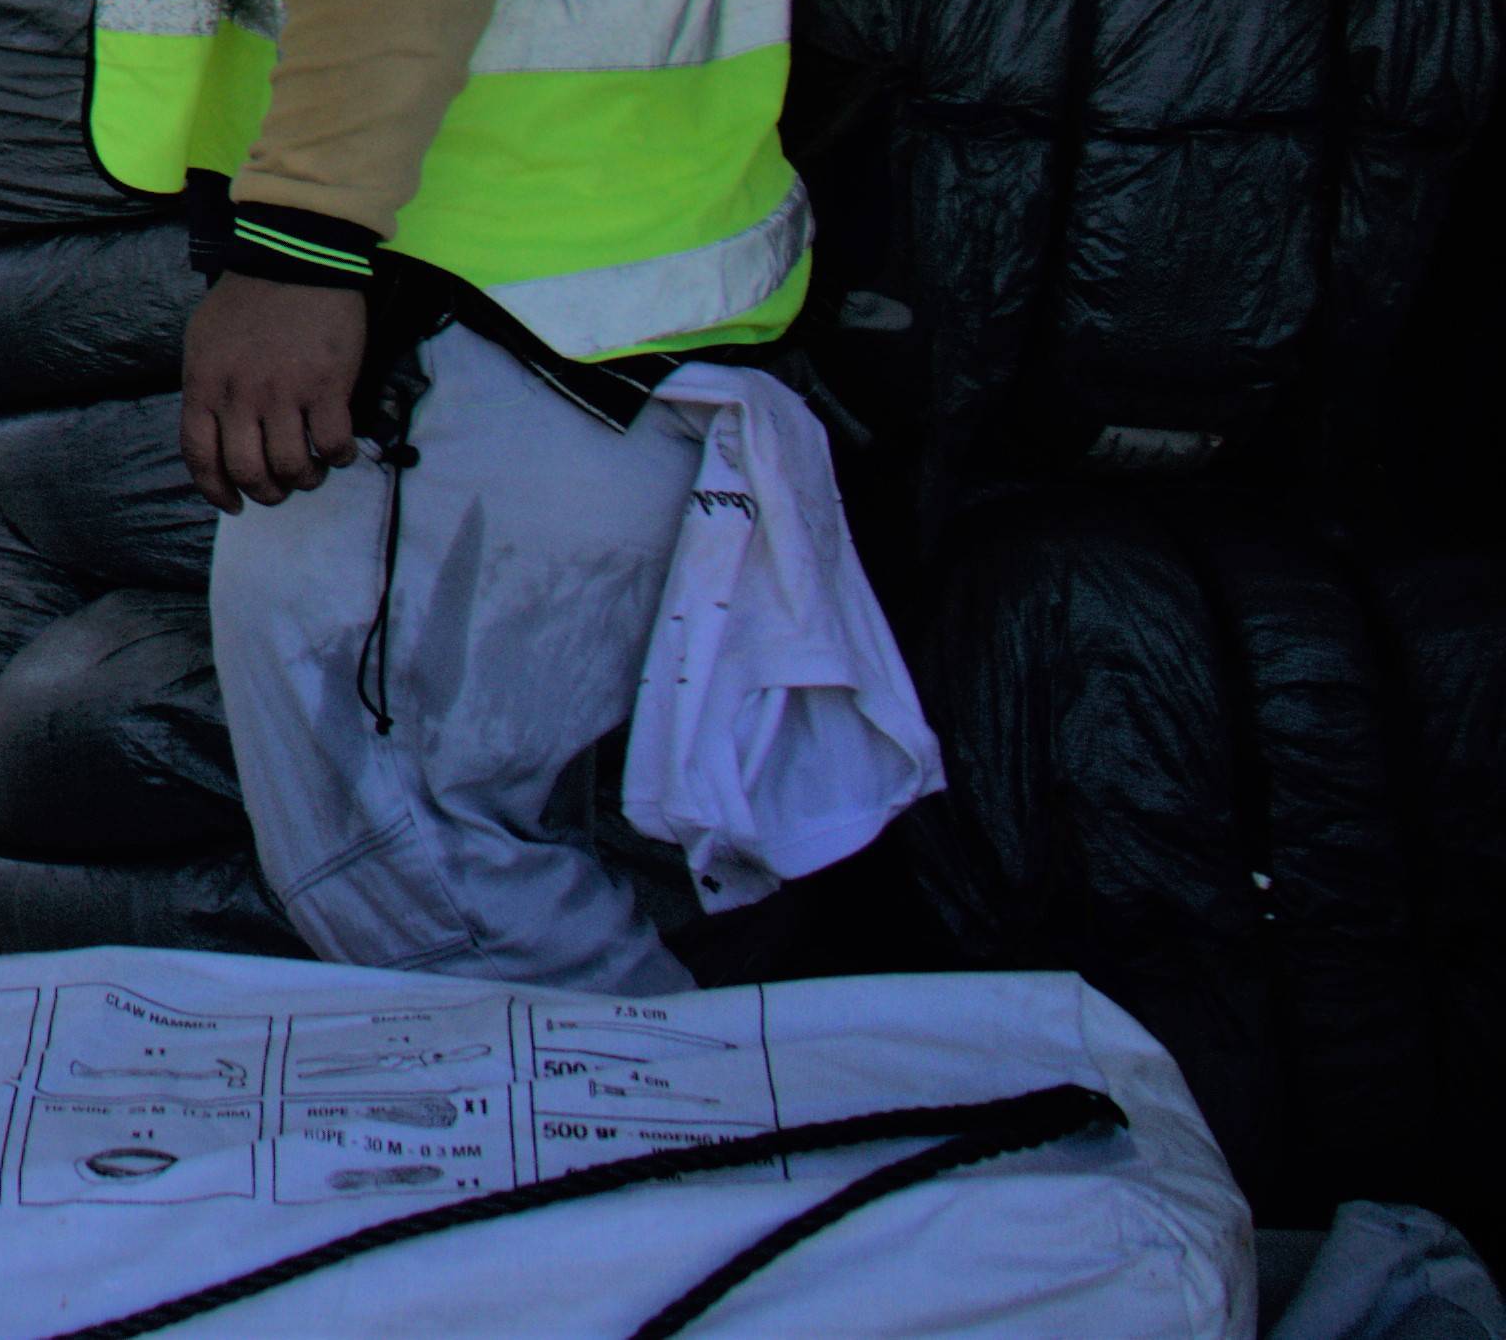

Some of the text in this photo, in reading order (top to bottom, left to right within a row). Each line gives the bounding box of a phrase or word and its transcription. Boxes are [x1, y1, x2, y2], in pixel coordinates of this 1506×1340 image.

[105, 992, 219, 1031] CLAW HAMMER
[303, 1127, 347, 1148] ROPE
[363, 1135, 383, 1154] 30
[387, 1140, 403, 1157] M
[451, 1143, 482, 1159] MM
[543, 1121, 589, 1140] 500
